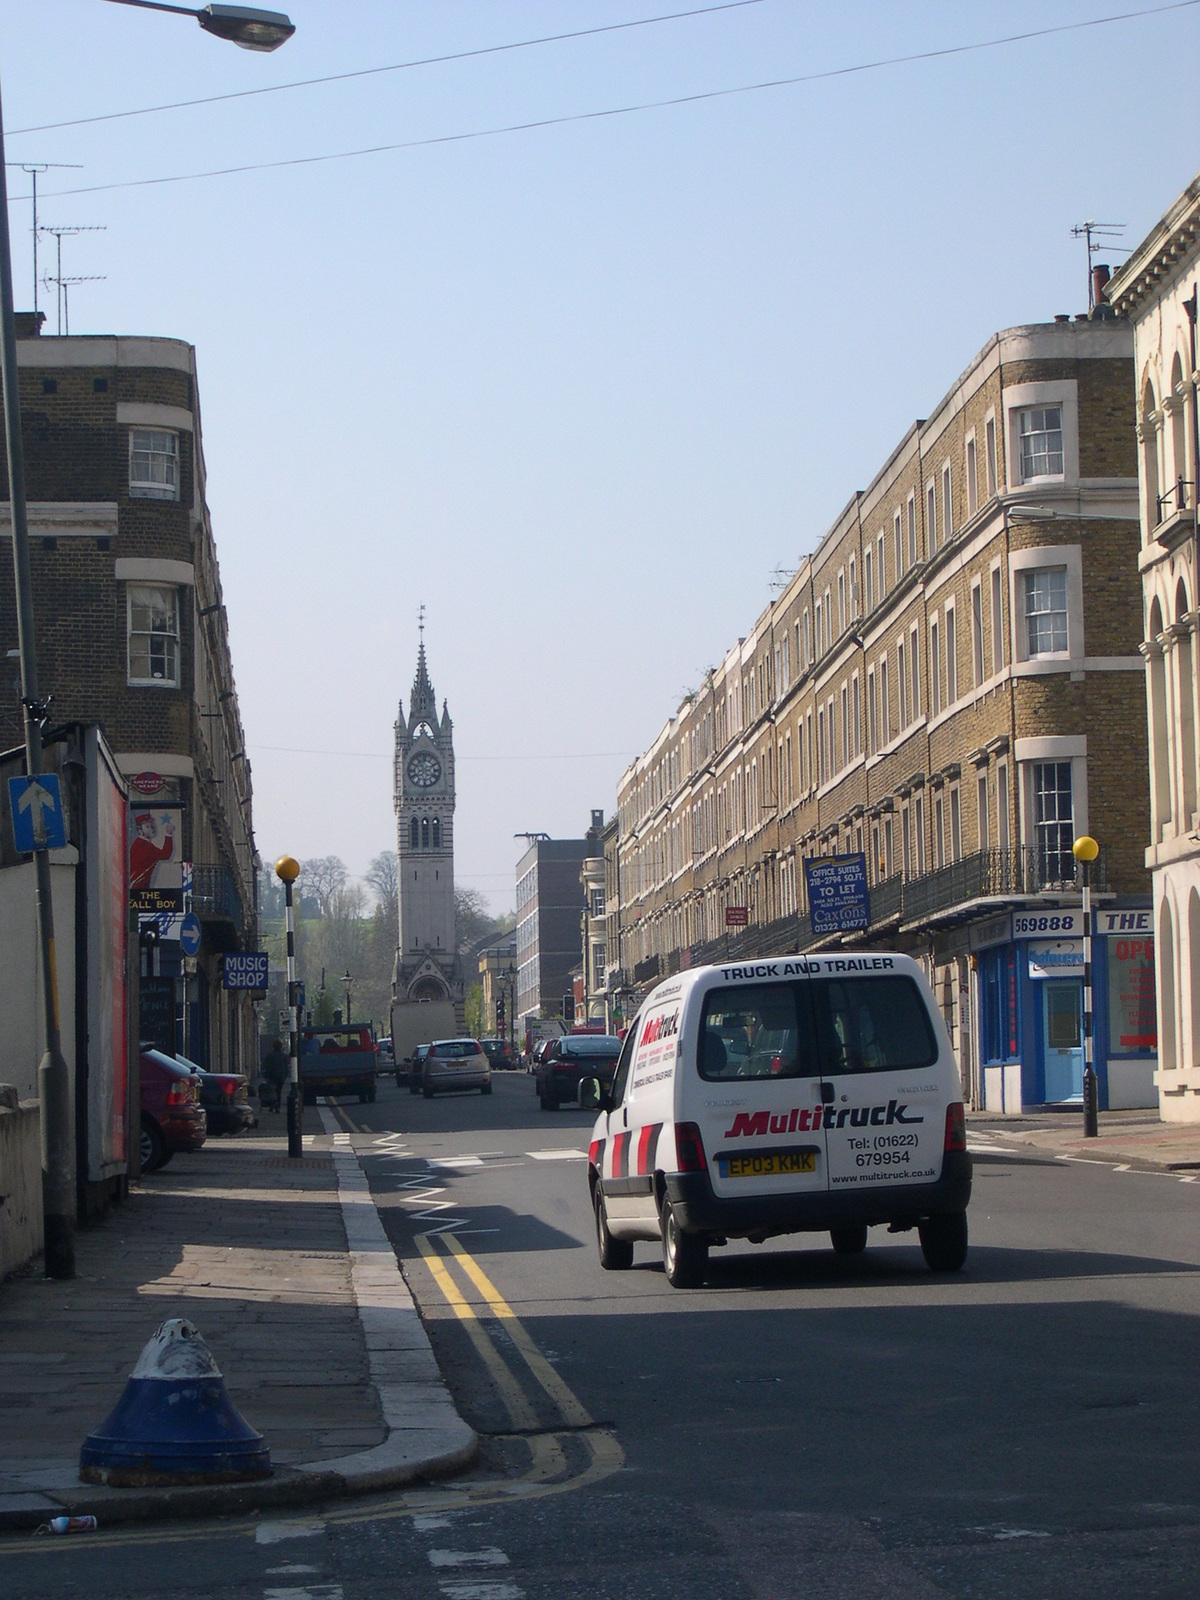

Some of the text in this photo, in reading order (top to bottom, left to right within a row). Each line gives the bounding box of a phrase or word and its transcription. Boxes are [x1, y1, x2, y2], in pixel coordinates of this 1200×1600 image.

[812, 865, 860, 877] OFFICE SUITES
[140, 891, 160, 899] THE
[819, 884, 855, 897] TO LET
[156, 900, 176, 909] BOY
[814, 907, 866, 922] Caxtons
[1105, 912, 1150, 930] THE
[814, 918, 868, 932] 01322 614771
[1015, 915, 1074, 933] 569888
[1116, 940, 1155, 961] OPE
[225, 957, 267, 971] MUSIC
[721, 957, 894, 981] TRUCK AND TRAILER
[228, 972, 265, 987] SHOP
[724, 1099, 924, 1139] Multitruck
[847, 1133, 919, 1150] Tel: (01622)
[730, 1154, 813, 1175] EP03 KMK
[855, 1150, 911, 1167] 679954
